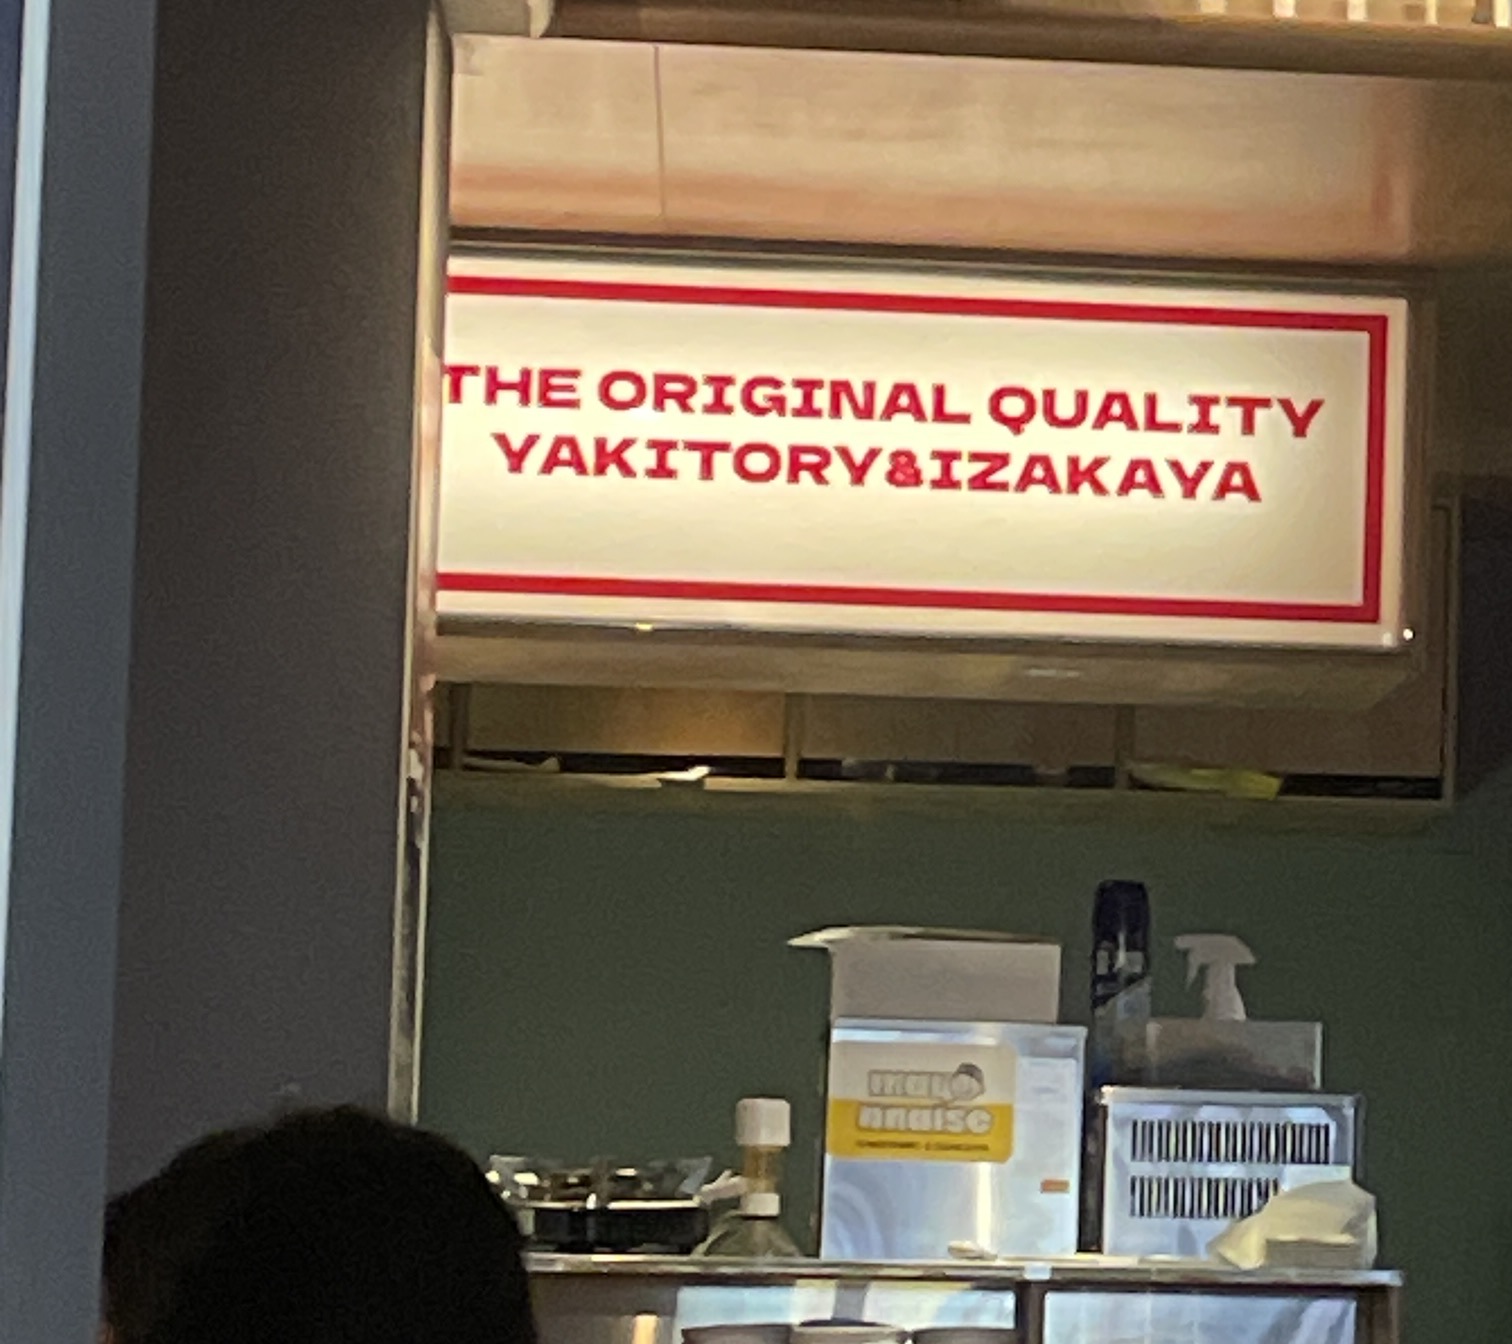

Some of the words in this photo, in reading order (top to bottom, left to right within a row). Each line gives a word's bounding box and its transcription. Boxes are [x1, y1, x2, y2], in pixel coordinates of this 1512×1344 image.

[441, 364, 582, 409] THE
[598, 369, 972, 424] ORIGINAL
[988, 385, 1324, 437] QUALITY
[494, 432, 1262, 501] YAKITORY&IZAKAYA
